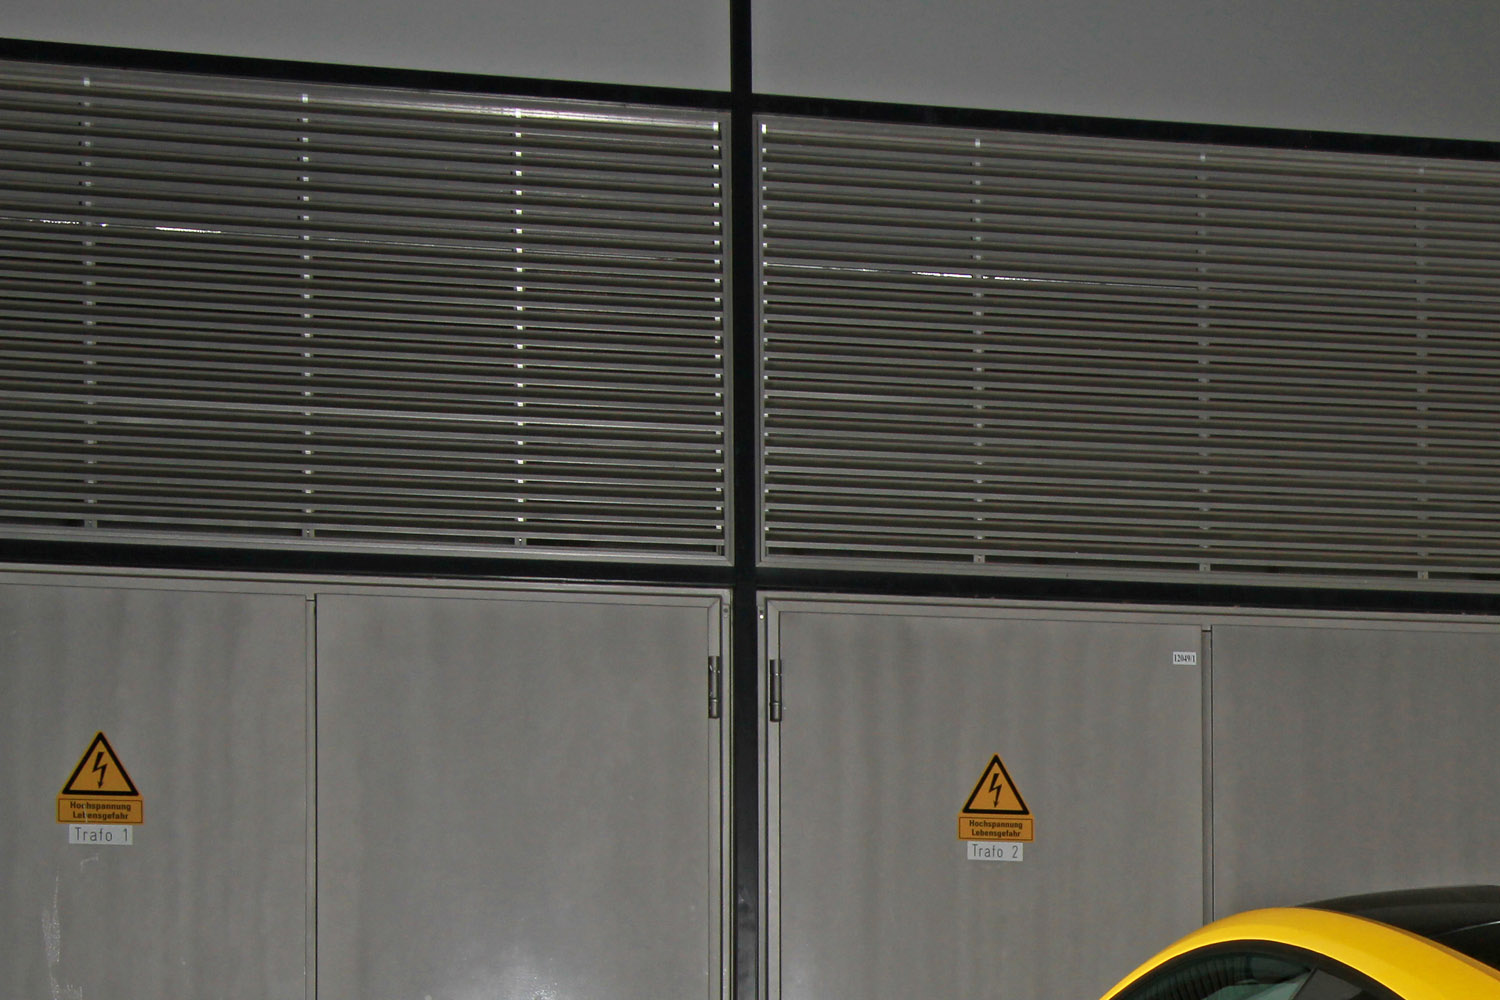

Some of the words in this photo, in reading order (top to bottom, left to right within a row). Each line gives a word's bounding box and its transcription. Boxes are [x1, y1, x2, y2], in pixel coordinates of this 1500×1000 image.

[70, 801, 131, 811] Hochspannung
[73, 811, 128, 820] Lebensgefahr
[969, 820, 1023, 829] Hochspannung
[75, 827, 112, 842] Trafo
[123, 828, 128, 842] 1
[971, 829, 1021, 838] Lebensgefahr
[972, 844, 1004, 857] Trafo
[1012, 845, 1019, 859] 2
